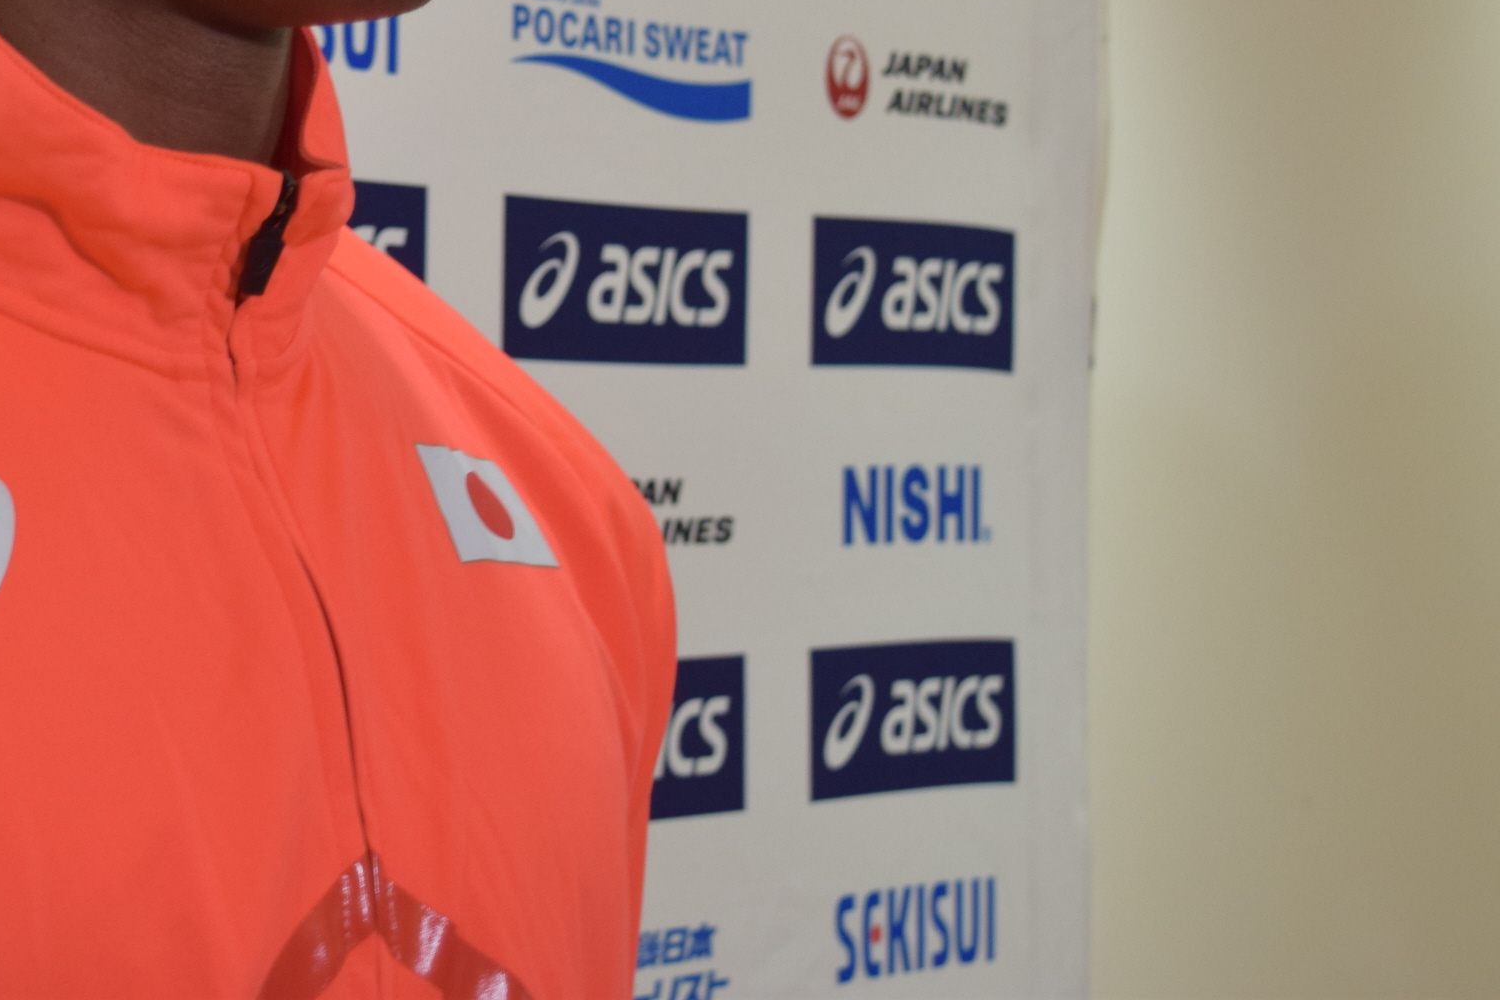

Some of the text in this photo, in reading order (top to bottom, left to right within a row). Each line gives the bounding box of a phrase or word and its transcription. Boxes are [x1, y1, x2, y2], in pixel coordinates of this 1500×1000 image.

[512, 3, 748, 67] POCARI SWEAT
[882, 52, 967, 83] JAPAN
[886, 89, 1008, 129] AIRLINES
[587, 244, 732, 327] asics
[882, 257, 1003, 335] asics
[881, 675, 1003, 755] asics
[836, 878, 995, 984] SEKISUI
